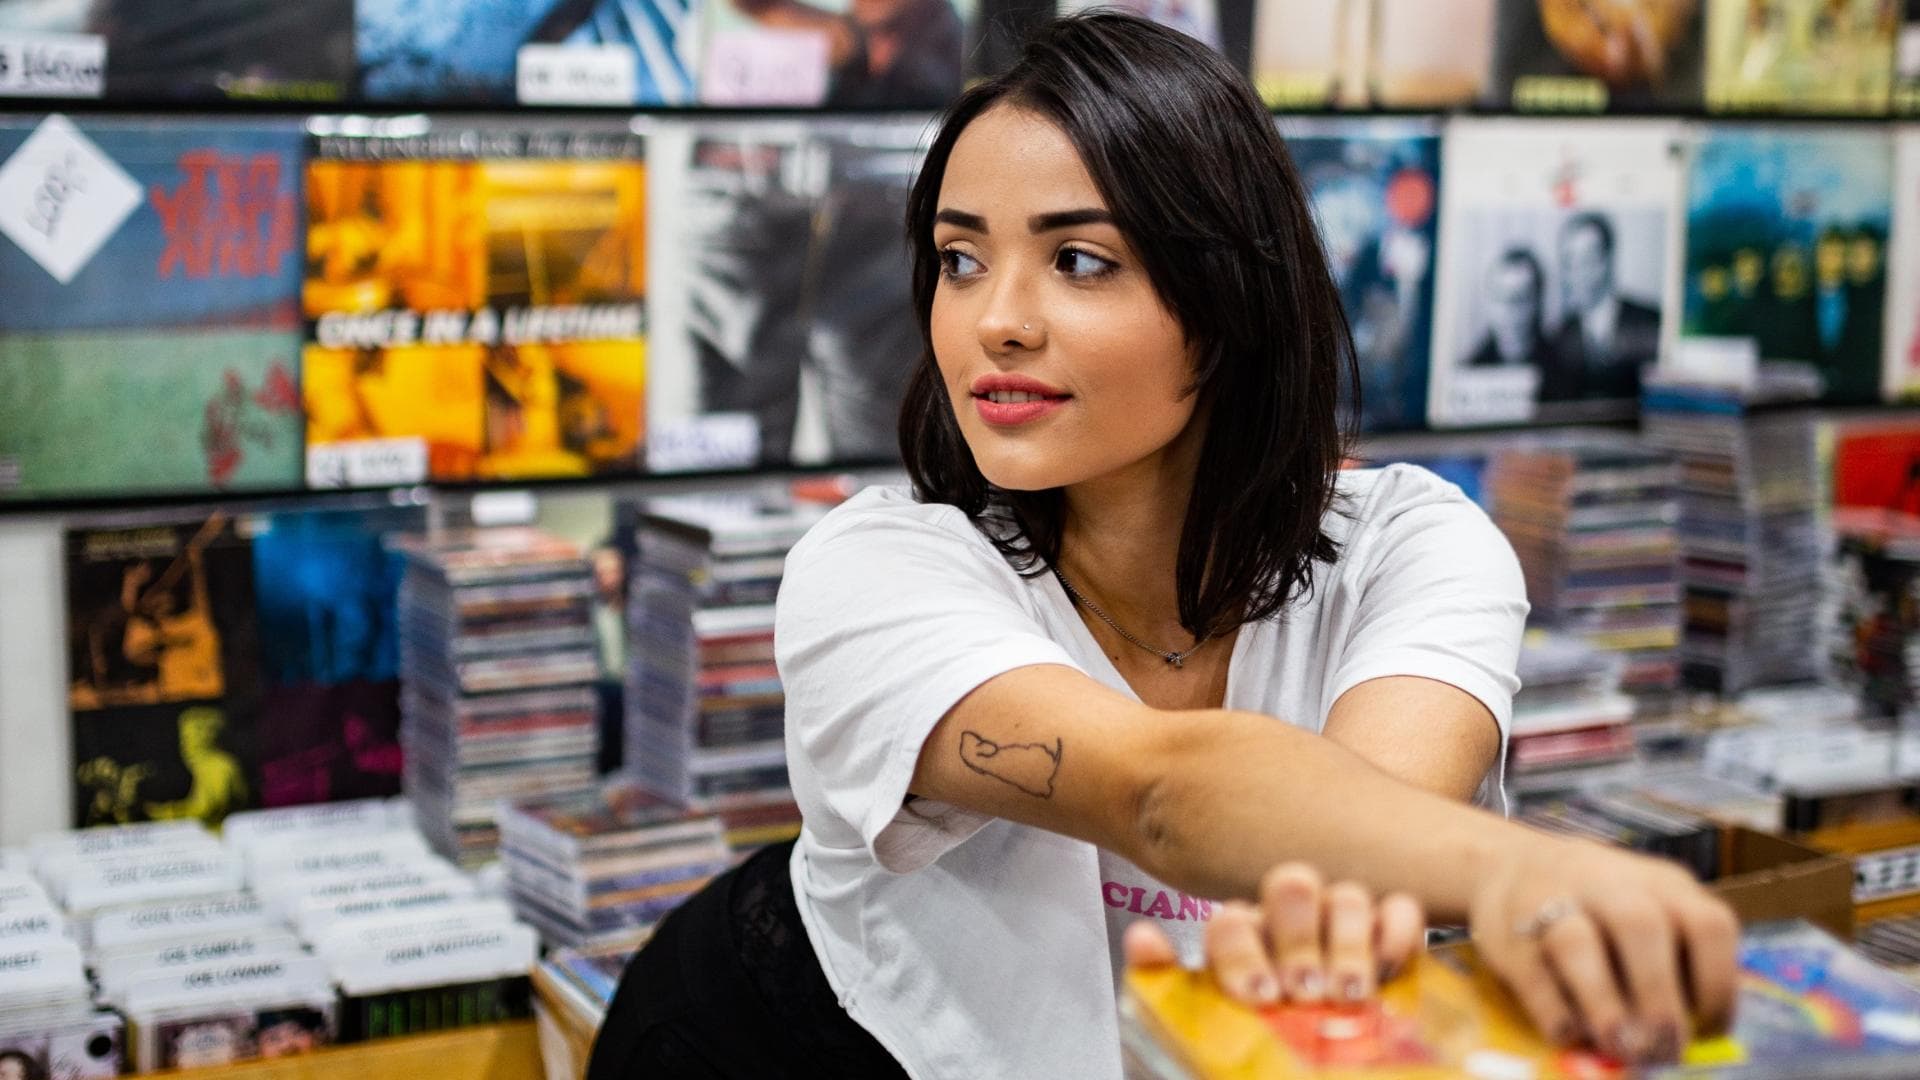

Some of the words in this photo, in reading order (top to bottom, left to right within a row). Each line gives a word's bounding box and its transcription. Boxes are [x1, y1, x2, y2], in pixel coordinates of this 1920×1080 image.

[317, 310, 418, 349] ONCE
[424, 309, 467, 346] IN
[469, 307, 500, 346] A
[183, 970, 214, 989] JOE
